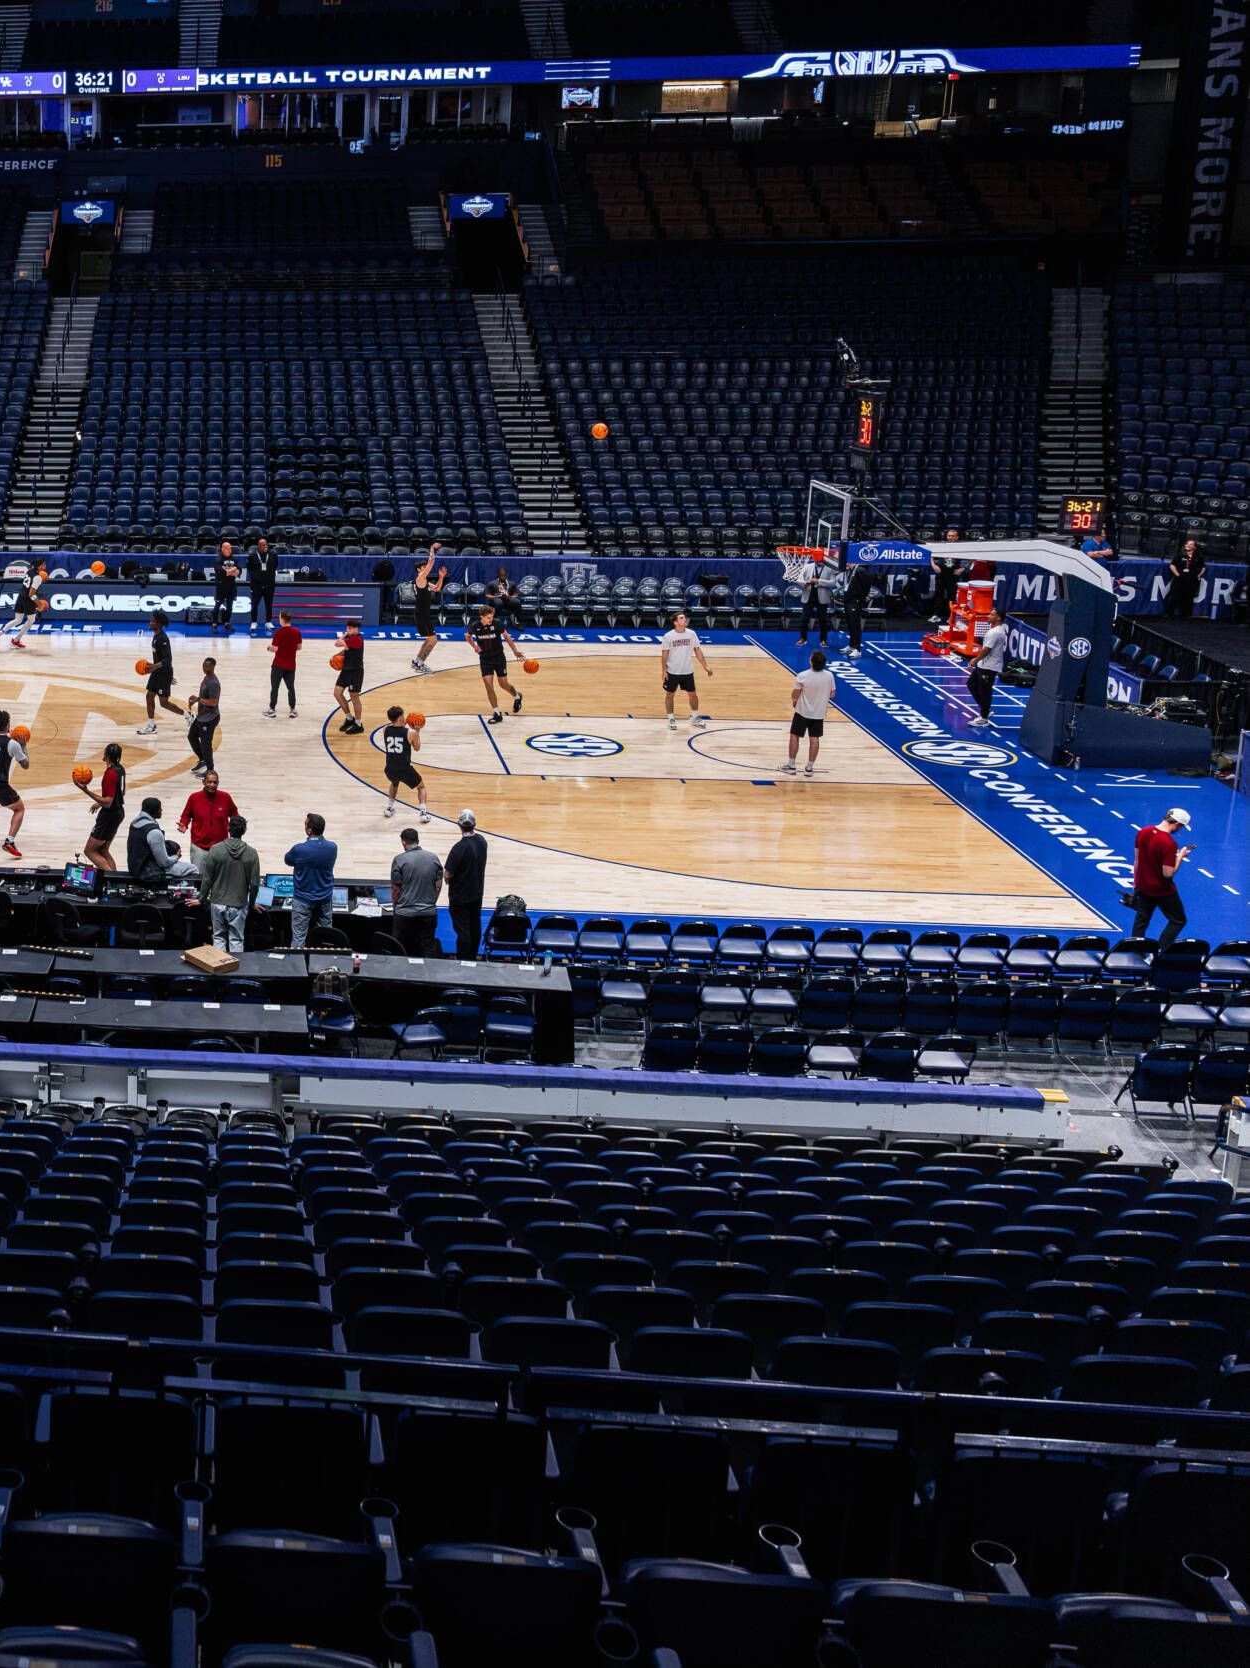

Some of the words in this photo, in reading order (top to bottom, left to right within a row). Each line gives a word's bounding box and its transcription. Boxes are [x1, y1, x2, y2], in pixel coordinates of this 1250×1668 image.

[1203, 0, 1248, 98] ANS
[52, 74, 62, 88] 0
[75, 72, 113, 87] 36:21
[126, 72, 137, 87] 0
[325, 67, 491, 82] TOURNAMENT
[264, 154, 283, 168] 115
[860, 418, 872, 445] 30
[1066, 500, 1102, 512] 36:21
[1073, 514, 1091, 528] 30
[879, 549, 923, 560] Allstate
[1070, 639, 1090, 658] SEC
[827, 661, 952, 738] SOUTHEASTERN
[386, 737, 403, 754] 25
